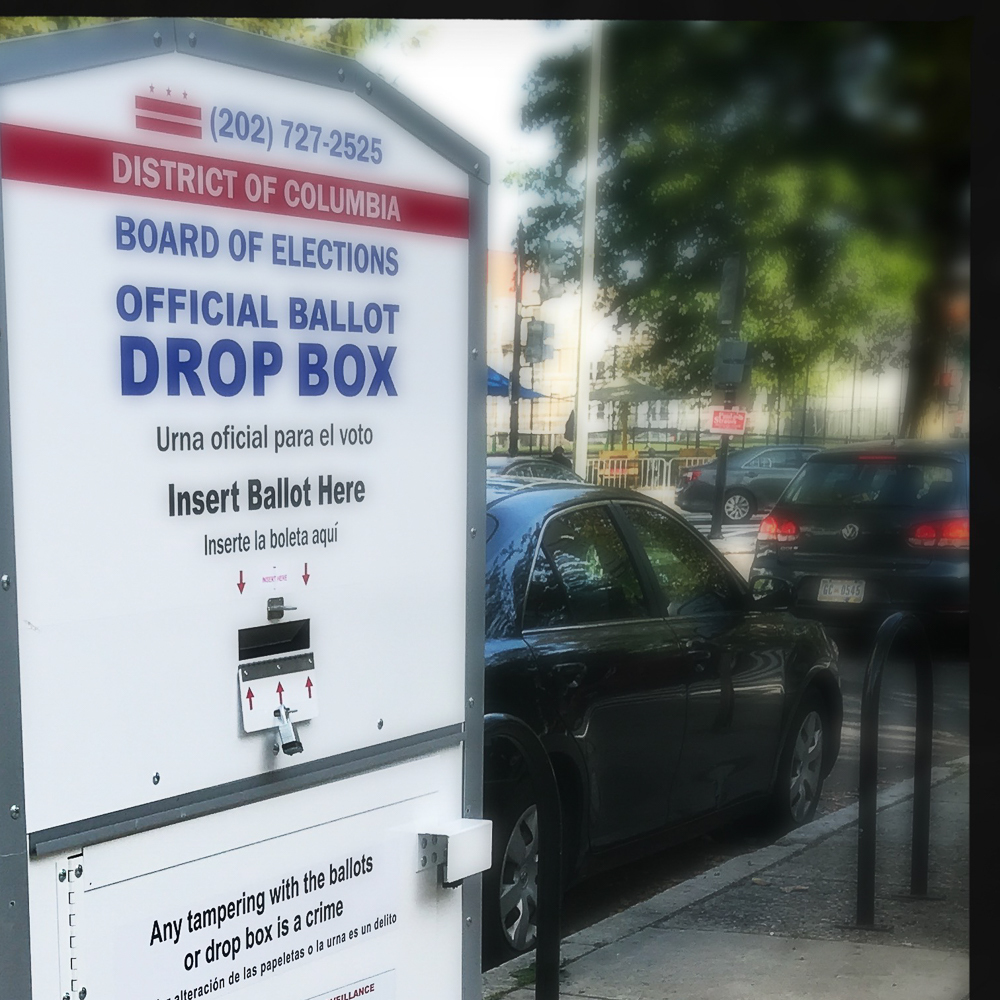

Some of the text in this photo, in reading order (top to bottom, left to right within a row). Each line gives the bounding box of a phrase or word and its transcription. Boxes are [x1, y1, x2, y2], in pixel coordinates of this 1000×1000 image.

[210, 106, 382, 165] (202) 727-2525
[112, 152, 401, 222] DISTRICT OF COLUMBIA
[115, 215, 399, 276] BOARD OF ELECTIONS
[116, 284, 400, 334] OFFICIAL BALLOT
[120, 336, 398, 397] DROP BOX
[157, 423, 373, 453] Urna oficial para el voto
[168, 475, 366, 516] Insert Ballot Here
[204, 522, 338, 555] Inserte la boleta aquí
[150, 854, 373, 946] Any tampering with the ballots
[184, 900, 344, 971] or drop box is a crime
[228, 970, 240, 986] de
[243, 965, 257, 980] las
[260, 948, 305, 975] papeletas
[308, 944, 314, 956] o
[316, 939, 324, 952] la
[327, 932, 346, 950] urna
[348, 928, 358, 941] es
[361, 923, 372, 936] un
[374, 912, 397, 932] delito
